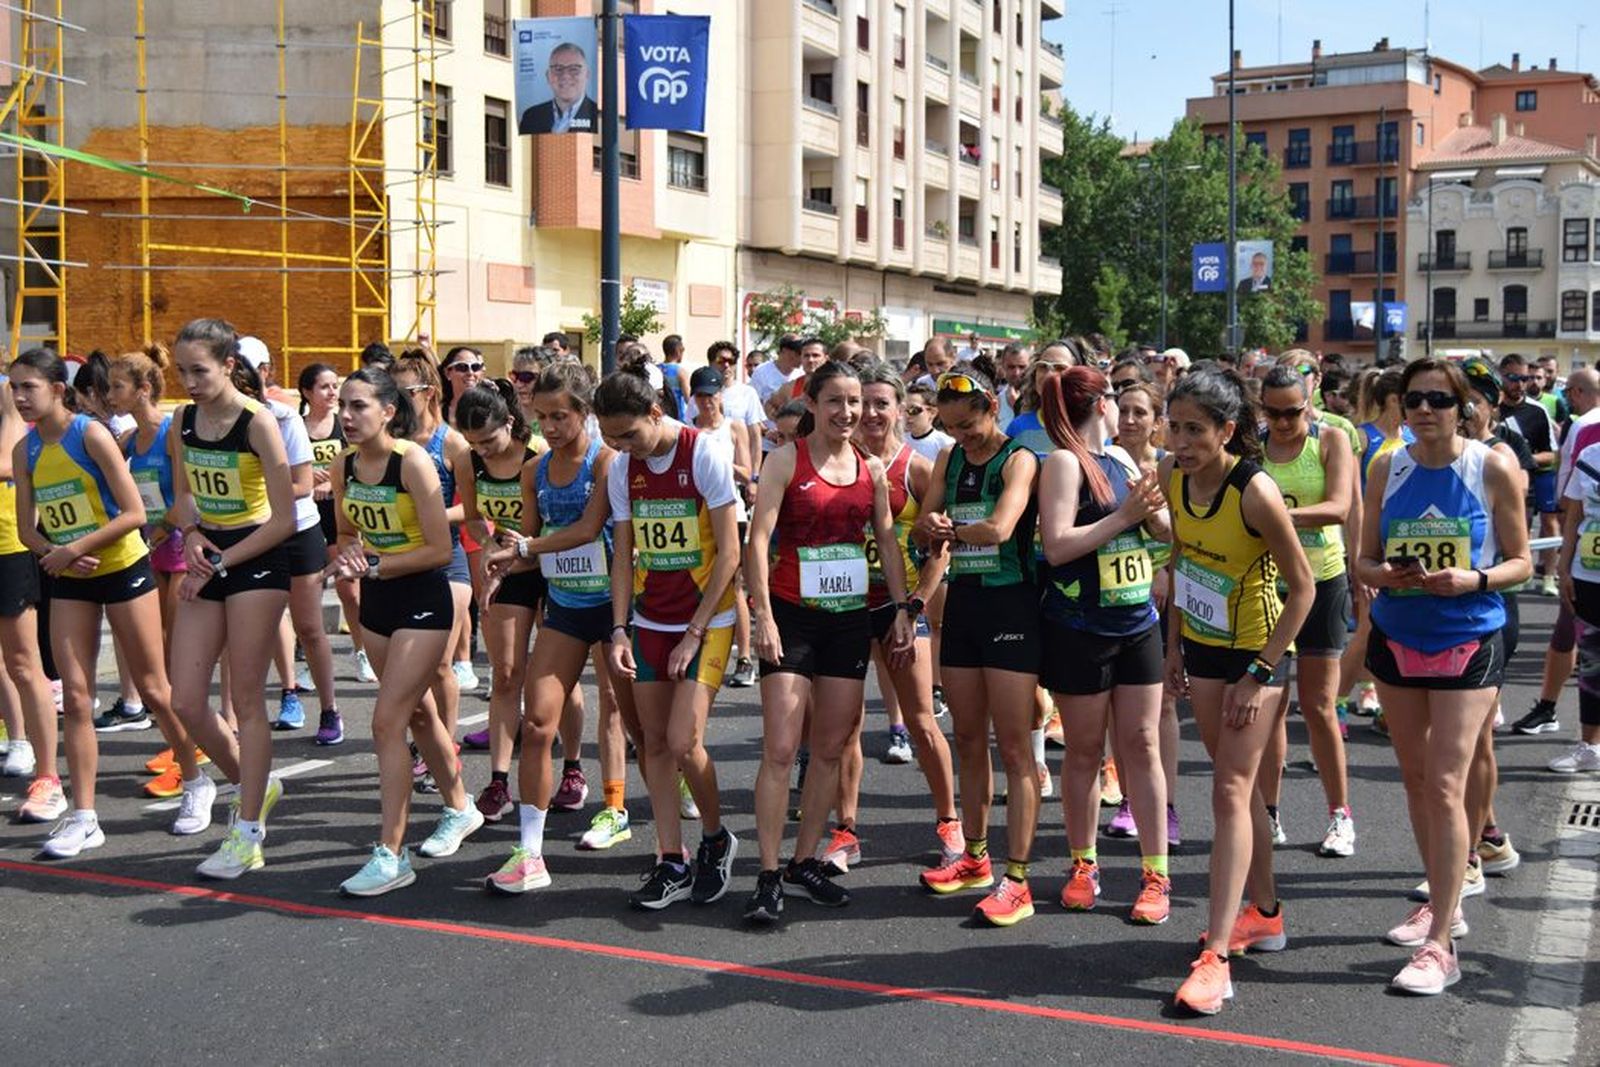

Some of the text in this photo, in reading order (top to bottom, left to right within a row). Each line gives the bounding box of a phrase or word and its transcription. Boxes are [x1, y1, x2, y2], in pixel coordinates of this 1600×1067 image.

[639, 46, 691, 63] VOTA
[1199, 256, 1220, 266] VOTA
[190, 470, 230, 497] 116
[46, 501, 78, 529] 30
[348, 503, 391, 531] 201
[483, 500, 524, 520] 122
[639, 521, 688, 550] 184
[555, 556, 593, 575] NOELIA
[1110, 554, 1147, 585] 161
